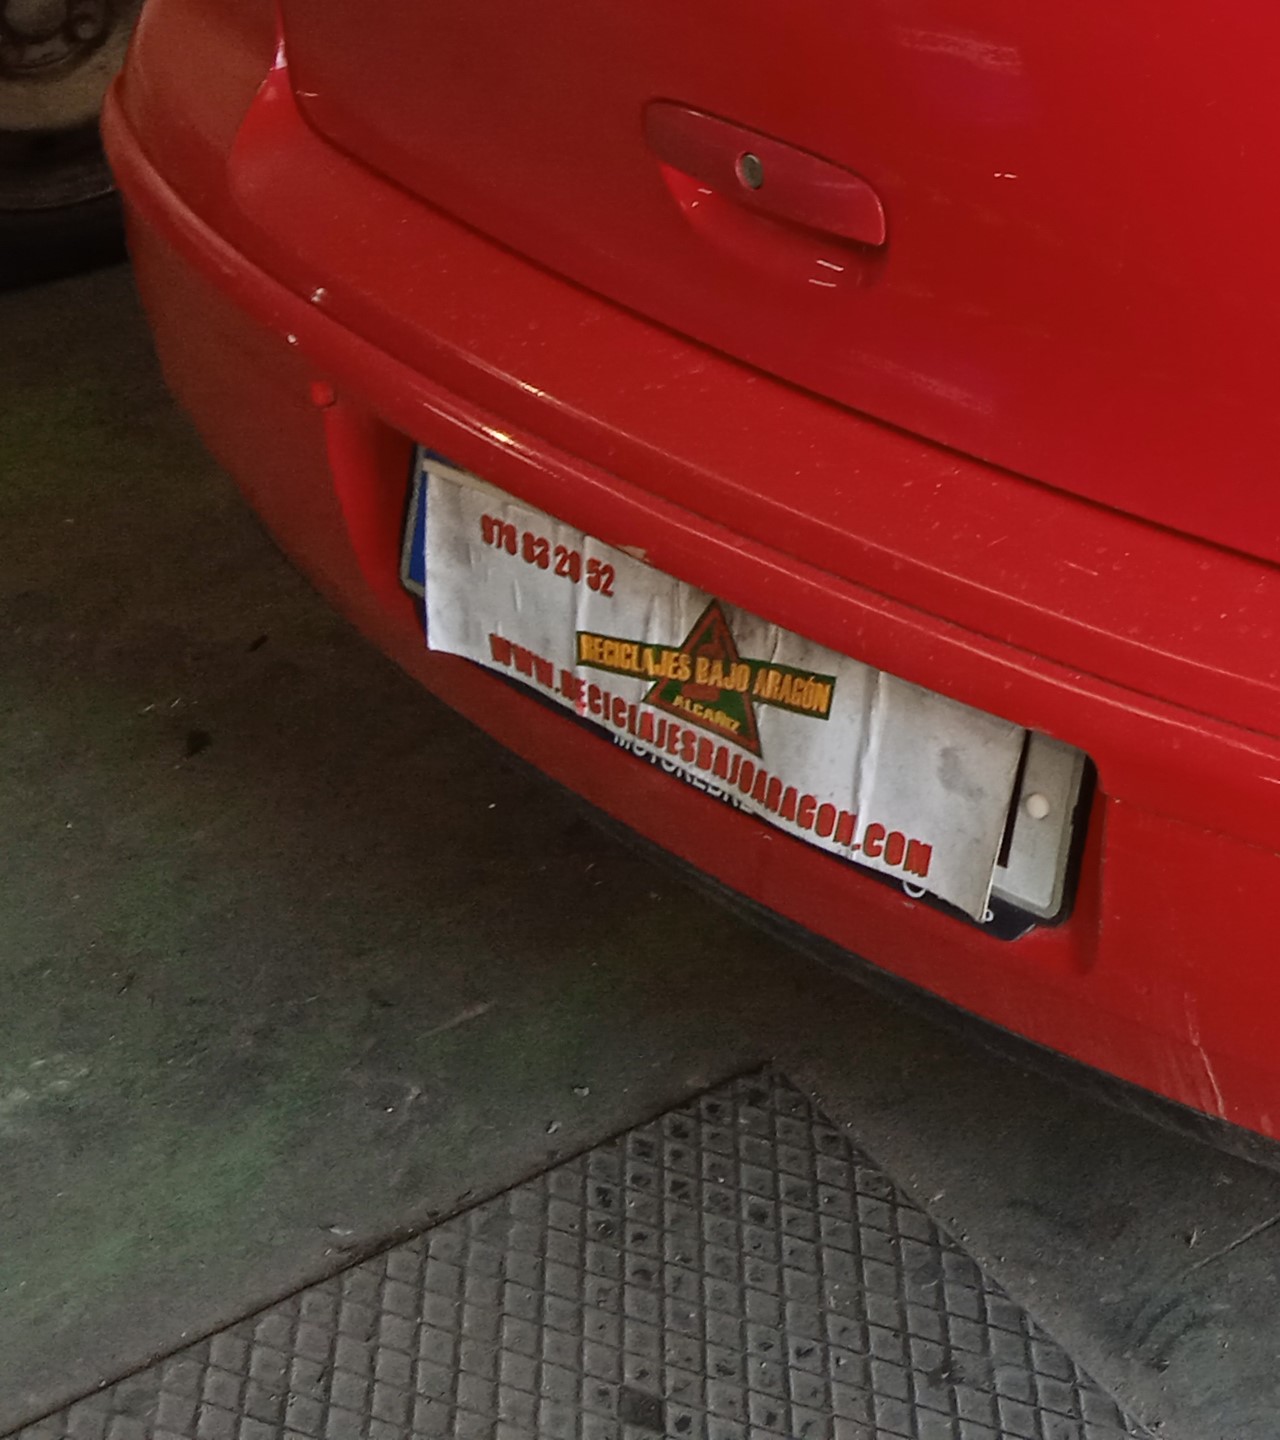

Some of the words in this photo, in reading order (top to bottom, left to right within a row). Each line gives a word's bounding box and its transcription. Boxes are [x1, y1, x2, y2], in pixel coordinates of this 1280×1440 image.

[586, 557, 615, 597] 52
[579, 634, 691, 682] RECICLAJES
[695, 657, 750, 692] BAJO
[752, 665, 832, 713] ARAGÓN
